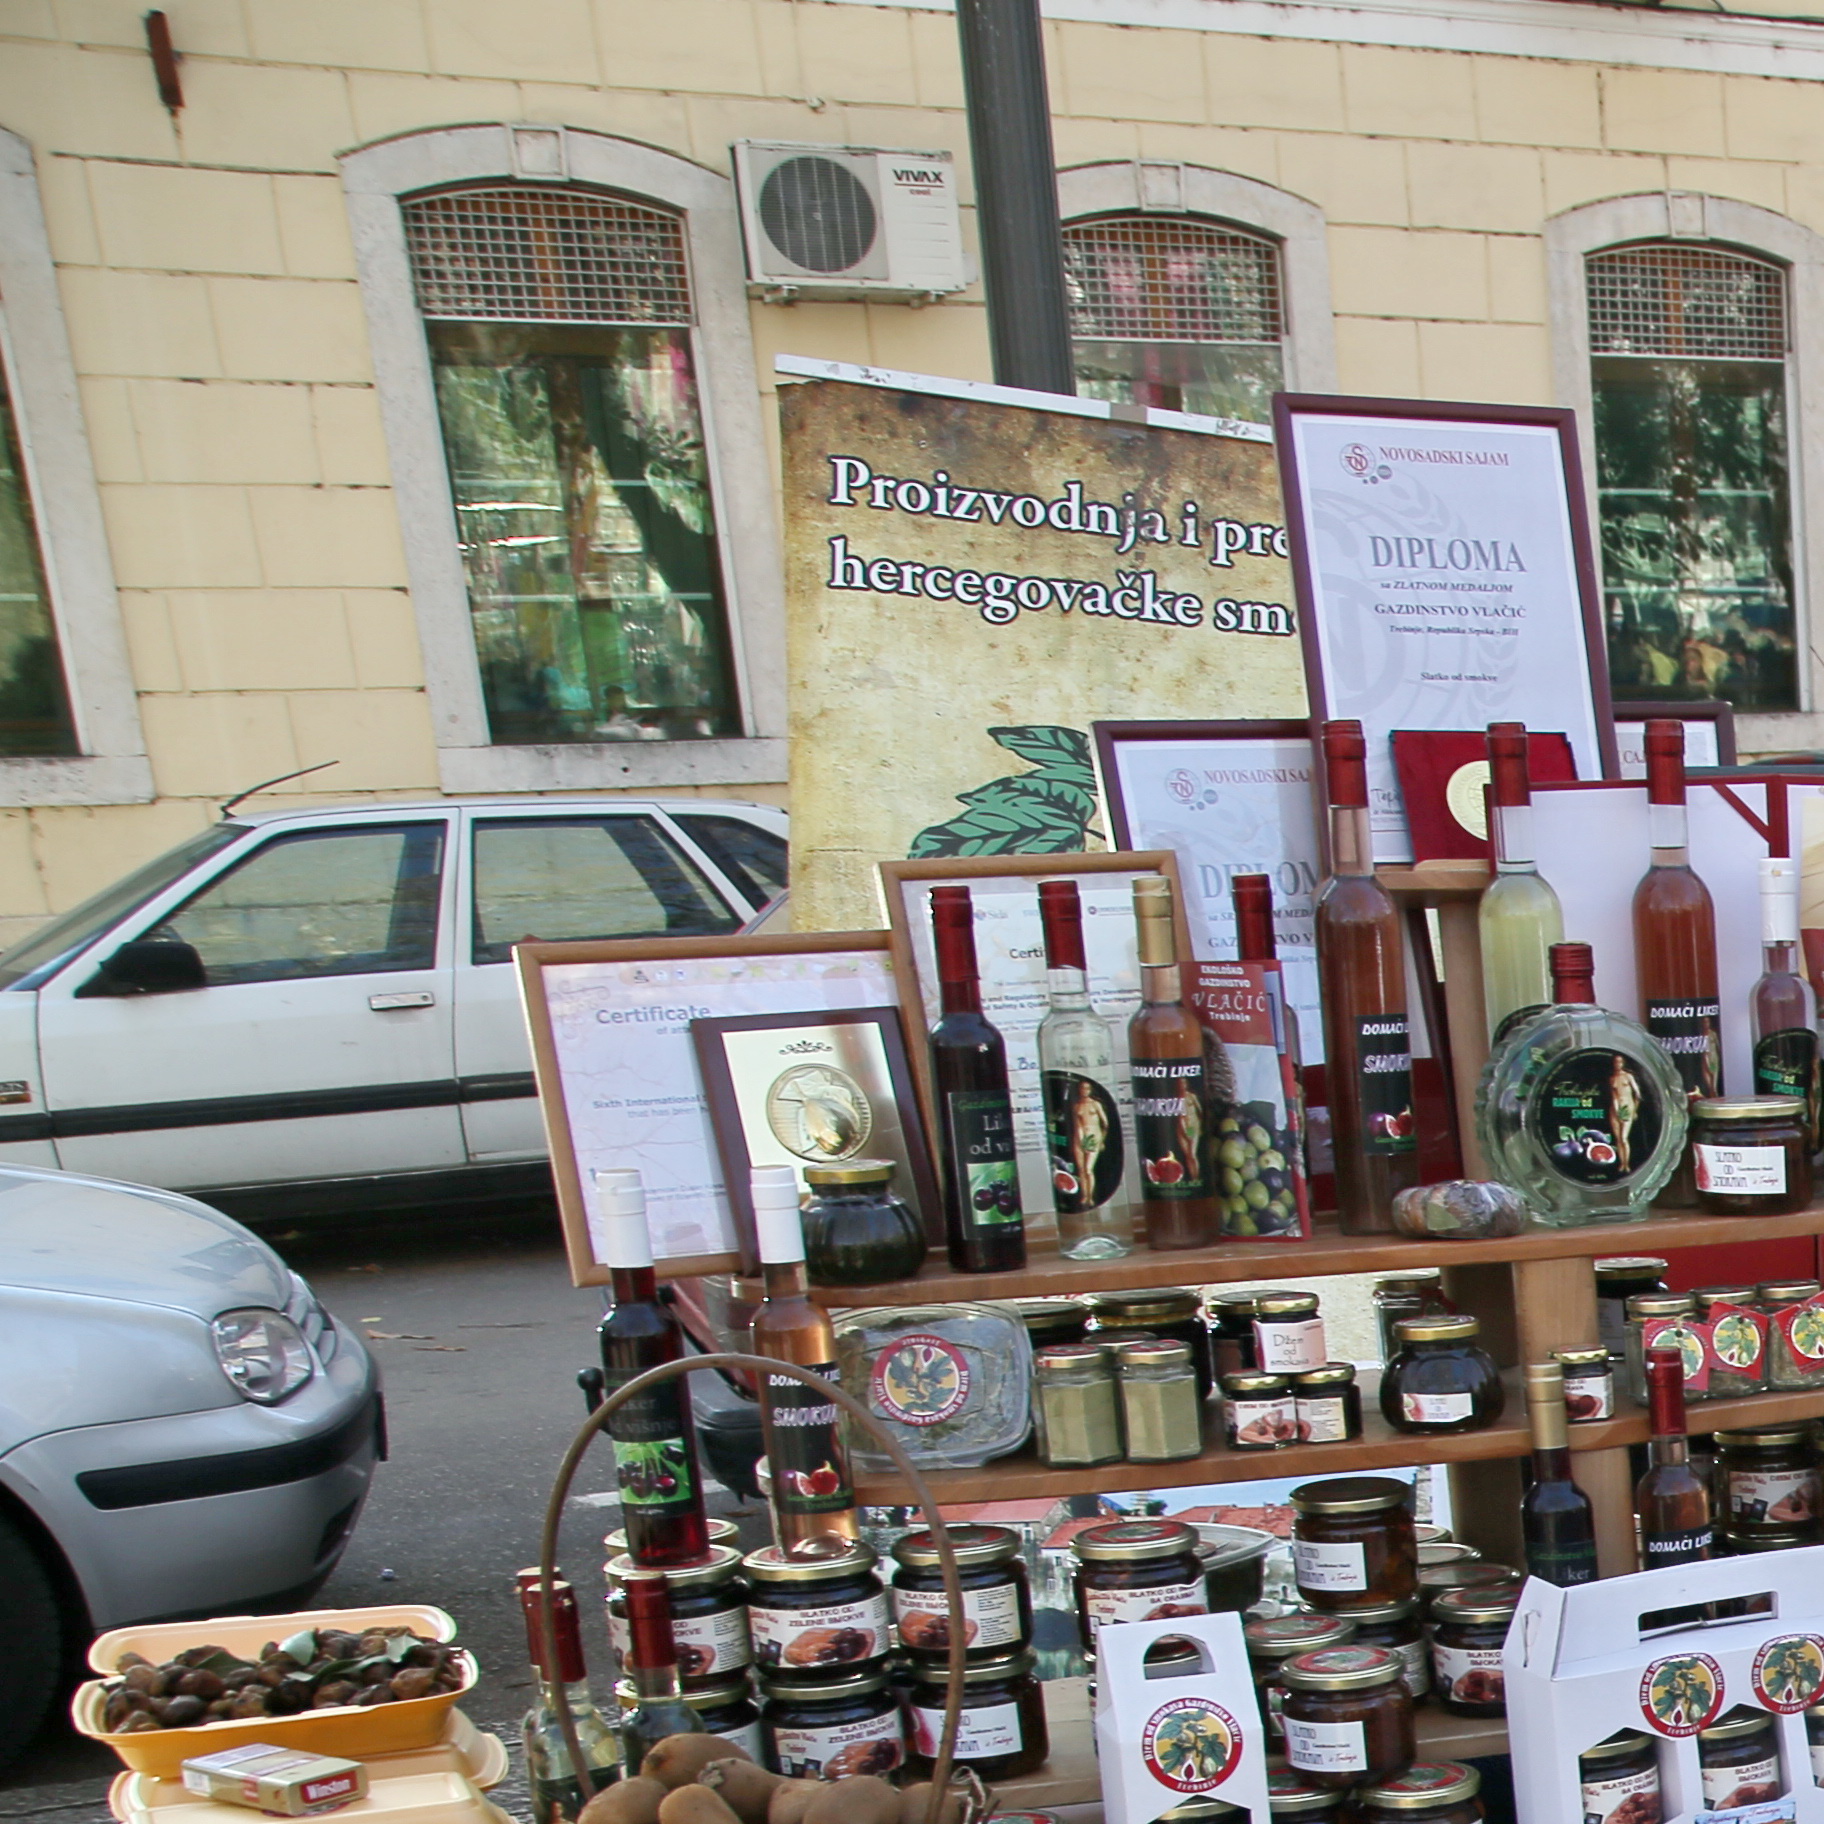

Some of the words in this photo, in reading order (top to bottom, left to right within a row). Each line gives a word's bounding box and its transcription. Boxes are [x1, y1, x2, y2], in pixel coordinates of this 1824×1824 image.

[893, 169, 944, 184] VIVAX
[1379, 446, 1463, 465] NOVOSADSKI
[1466, 451, 1509, 466] SAJAM
[829, 456, 1169, 552] Proizvodnja
[1182, 502, 1200, 547] i
[1369, 535, 1527, 573] DIPLOMA
[829, 537, 1204, 625] hercegovačke
[1212, 594, 1297, 638] sm
[1393, 581, 1447, 591] ZLATNOM
[1451, 582, 1513, 593] MEDALJOM
[1375, 603, 1469, 617] GAZDINSTVO
[1472, 604, 1527, 619] VLAČIĆ
[1420, 672, 1449, 682] Slatko
[1451, 673, 1462, 682] od
[1203, 769, 1288, 784] NOVOSADSKI
[1193, 990, 1265, 1011] VLAČIĆ
[596, 1004, 711, 1025] Certificate
[1651, 1002, 1693, 1018] DOMAČI
[593, 1098, 623, 1109] Sixth
[625, 1094, 700, 1109] International
[1649, 1535, 1693, 1552] DOMAČI
[306, 1779, 351, 1800] Winston
